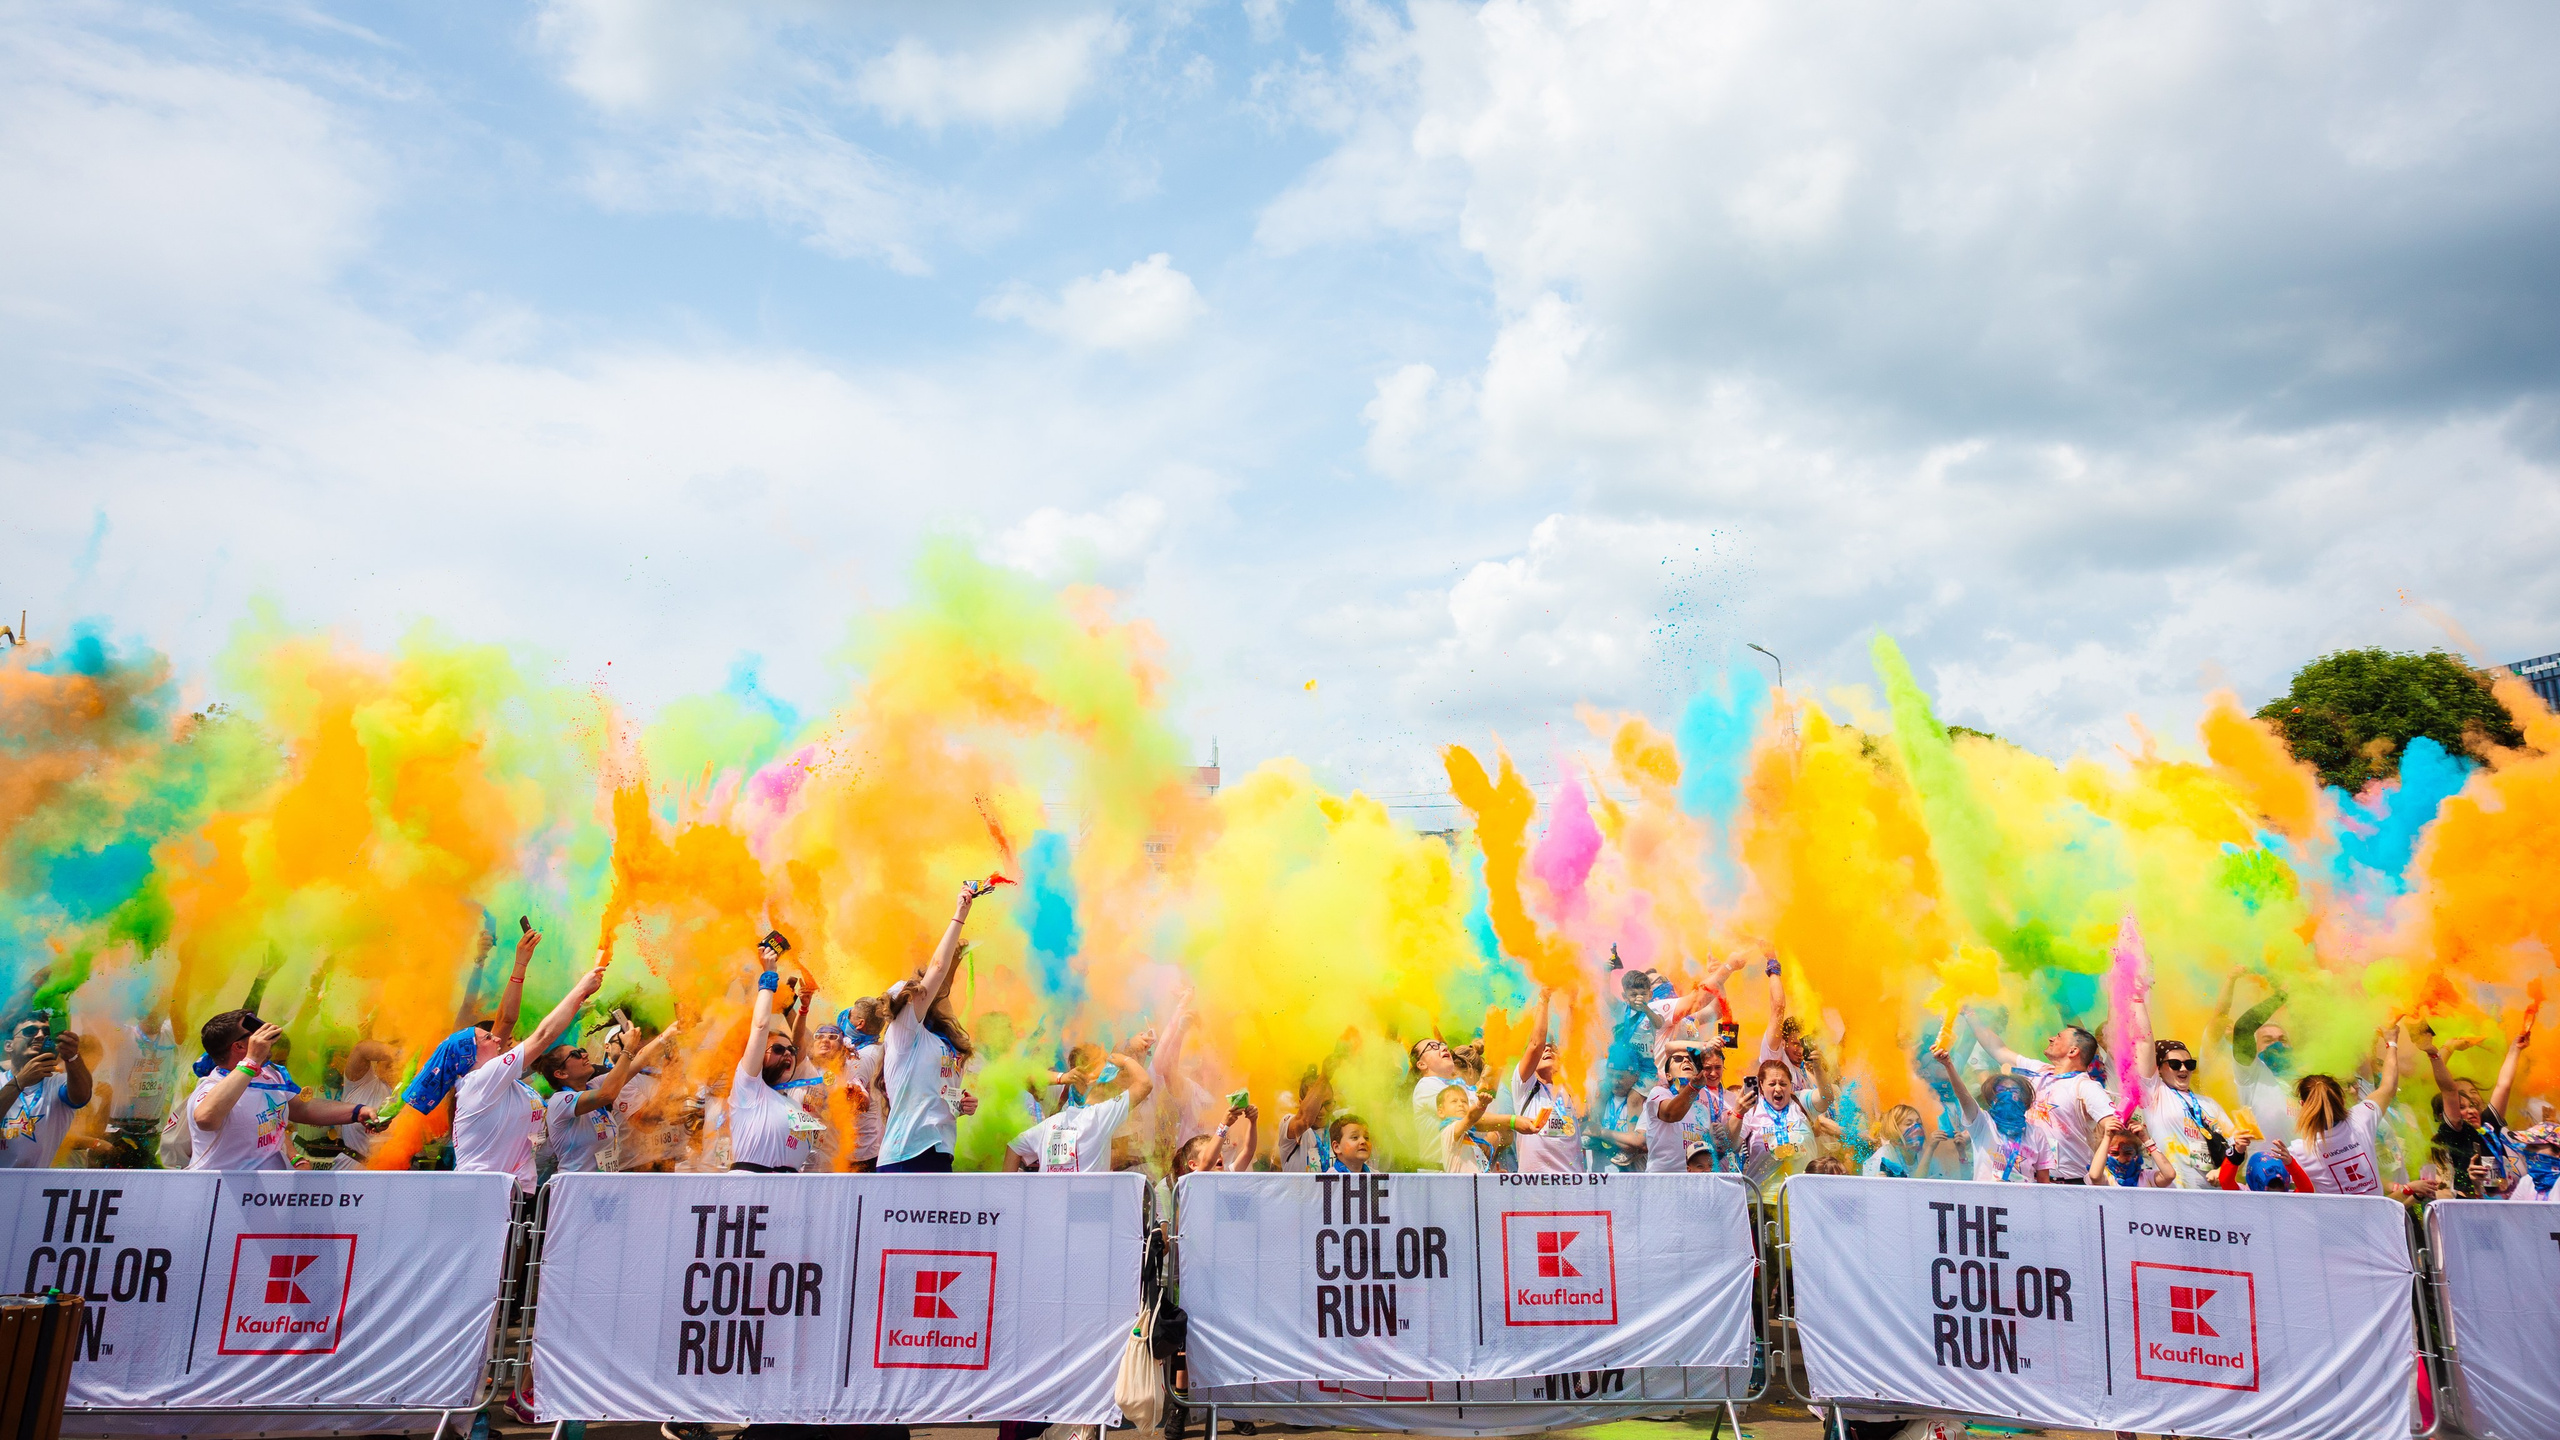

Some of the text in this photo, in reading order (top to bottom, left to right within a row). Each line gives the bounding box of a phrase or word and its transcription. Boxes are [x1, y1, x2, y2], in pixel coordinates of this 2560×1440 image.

[256, 1109, 269, 1125] THE
[1682, 1123, 1695, 1132] THE
[242, 1193, 363, 1207] POWERED BY
[1316, 1174, 1389, 1224] THE
[1500, 1174, 1608, 1186] POWERED BY
[42, 1189, 123, 1243] THE
[692, 1206, 768, 1258] THE
[885, 1210, 1000, 1225] POWERED BY
[1930, 1202, 2009, 1261] THE
[2129, 1222, 2251, 1246] POWERED BY
[25, 1246, 172, 1303] COLOR
[1316, 1227, 1448, 1281] COLOR
[683, 1262, 823, 1316] COLOR
[1317, 1284, 1397, 1338] RUN
[1518, 1288, 1604, 1305] Kaufland
[1931, 1258, 2073, 1322] COLOR
[236, 1316, 330, 1333] Kaufland
[678, 1320, 763, 1375] RUN
[889, 1330, 978, 1349] Kaufland
[1934, 1313, 2018, 1374] RUN
[2149, 1343, 2244, 1369] Kaufland
